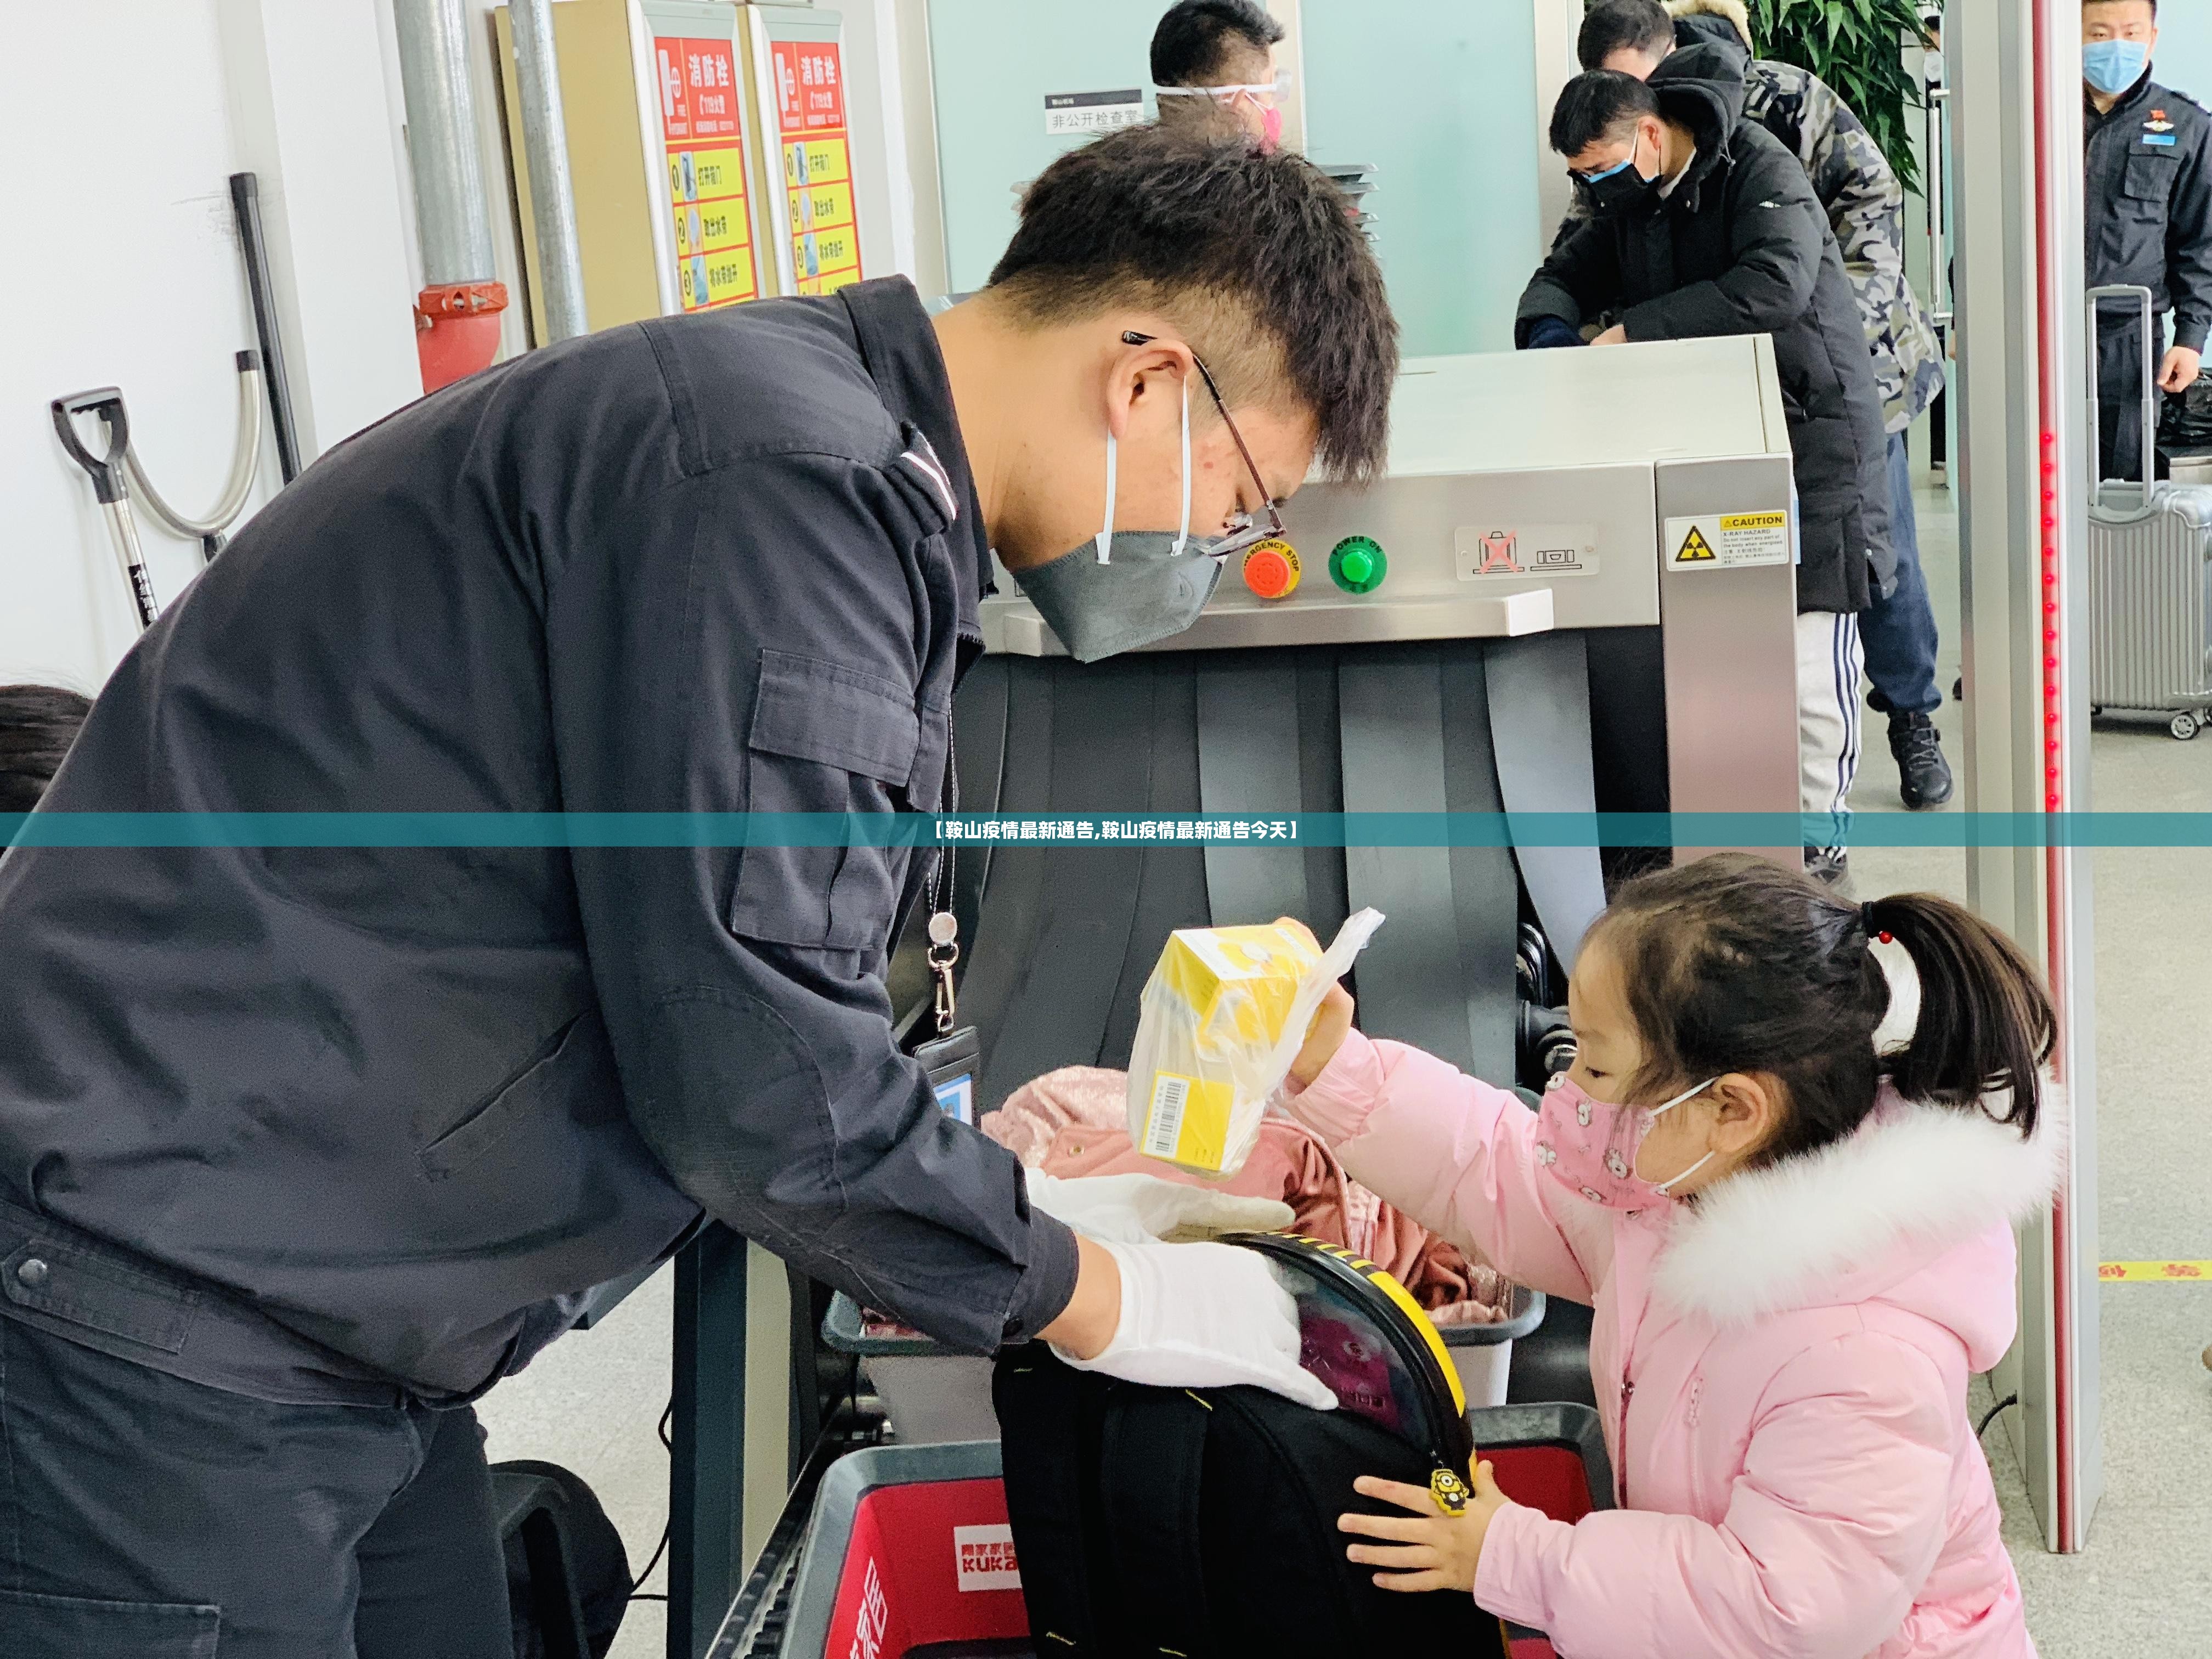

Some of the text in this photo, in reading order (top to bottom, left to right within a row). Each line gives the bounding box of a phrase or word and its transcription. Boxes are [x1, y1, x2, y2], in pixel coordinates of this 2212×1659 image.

[689, 54, 730, 87] 消防栓
[801, 56, 837, 85] 消防栓
[1052, 110, 1138, 128] 非公开检查室
[698, 165, 722, 187] 打开箱门
[1733, 516, 1782, 527] CAUTION
[1332, 536, 1383, 556] POWER ON
[1286, 550, 1299, 571] STOP
